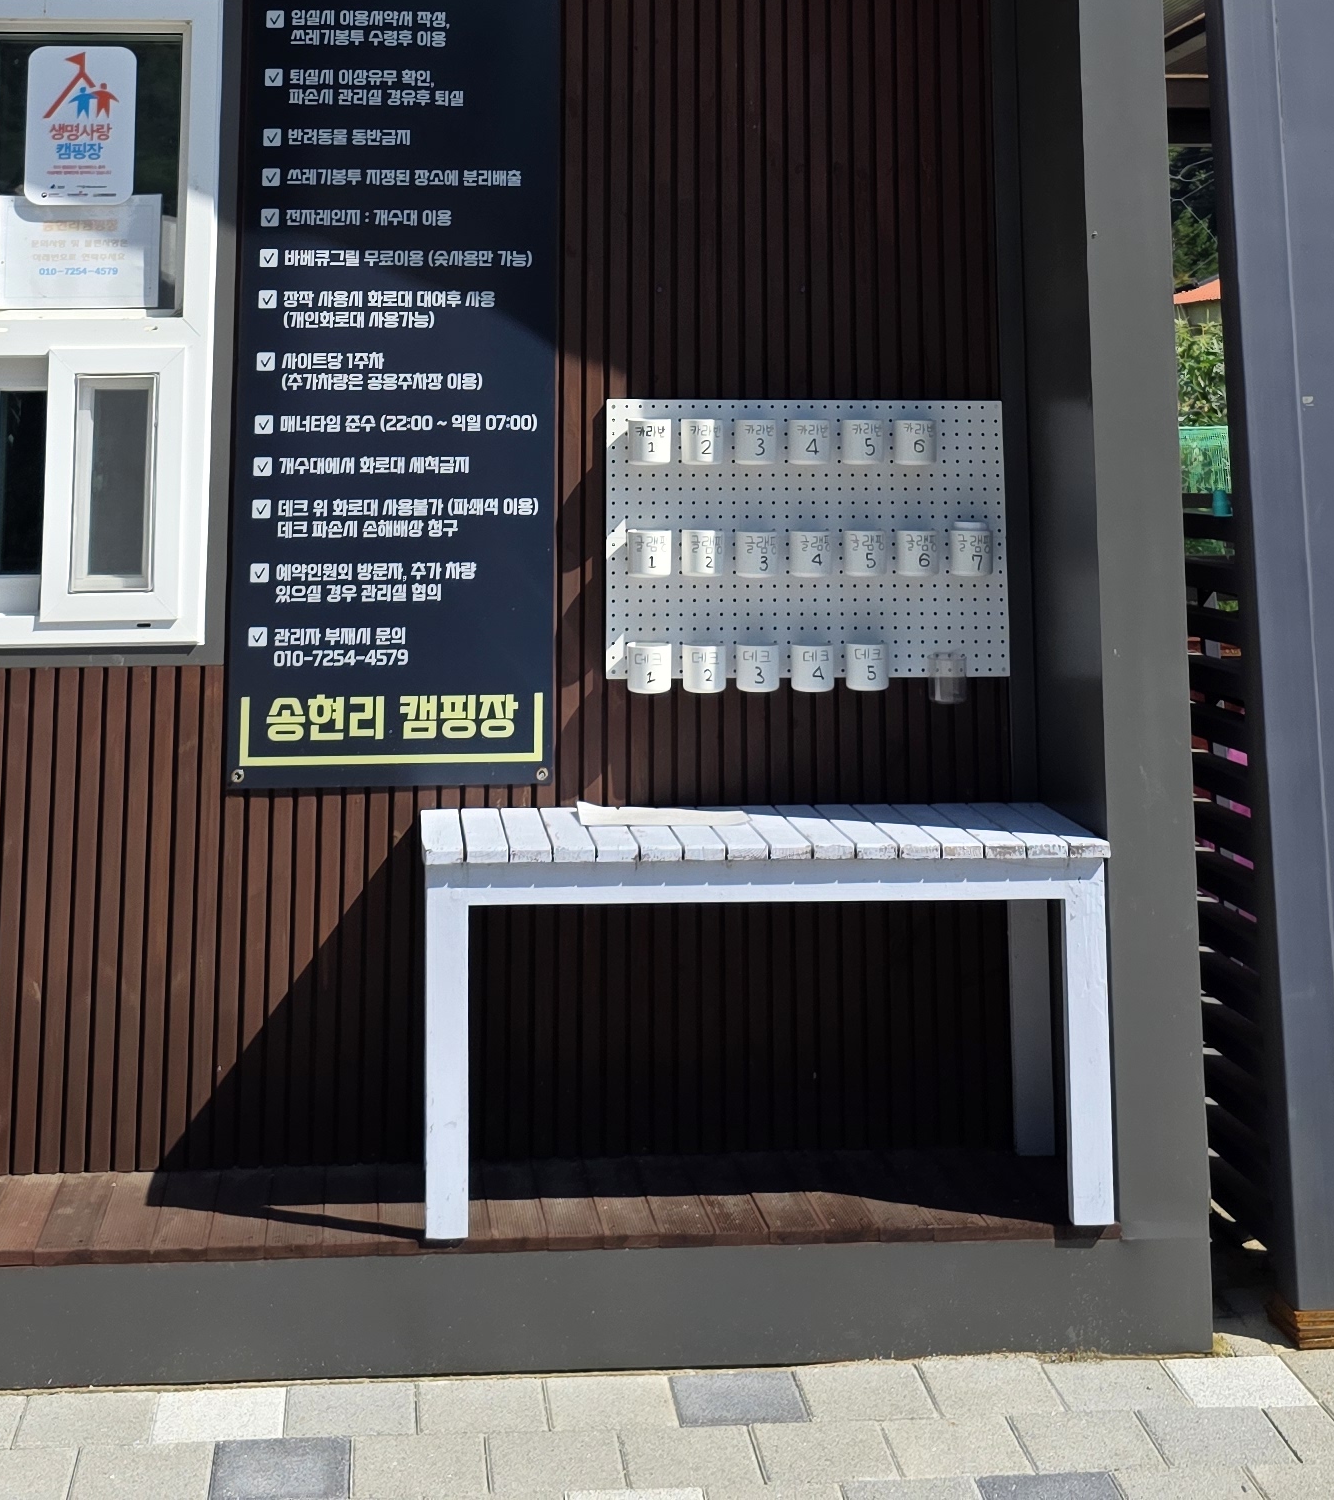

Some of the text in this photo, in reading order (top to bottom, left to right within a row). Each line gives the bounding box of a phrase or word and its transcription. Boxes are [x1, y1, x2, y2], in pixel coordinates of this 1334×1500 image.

[291, 9, 450, 30] 입실시 이용서약서 작성,
[290, 27, 449, 48] 쓰레기봉투 수령후 이용
[289, 68, 435, 88] 퇴실시 이상유무 확인,
[288, 88, 464, 107] 파손시 관리실 경유후 퇴실
[49, 123, 113, 140] 생명사랑
[287, 128, 411, 146] 반려동물 동반금지
[56, 142, 103, 160] 캠핑장
[286, 168, 522, 187] 쓰레기봉투 지정된 장소에 분리배출
[285, 209, 452, 227] 전자레인지 : 개수대 이용
[284, 249, 533, 268] 바베큐그릴 무료이용 (숯사용만 가능)
[39, 267, 119, 276] 010-7254-4579
[283, 289, 496, 308] 장작 사용시 화로대 대여후 사용
[283, 310, 435, 329] (개인화로대 사용가능)
[281, 351, 385, 370] 사이트당 1주차
[281, 372, 483, 391] (추가차량은 공용주차장 이용)
[279, 414, 341, 433] 매너타임
[344, 414, 377, 433] 준수
[379, 414, 434, 433] (22:00
[451, 414, 481, 432] 익일
[485, 413, 538, 432] 07:00)
[635, 425, 665, 438] 카라반
[690, 424, 721, 438] 카라반
[745, 424, 775, 436] 카라반
[797, 424, 829, 438] 카라반
[851, 422, 882, 438] 카라반
[903, 422, 935, 438] 카라반
[648, 442, 655, 452] 1
[701, 440, 712, 454] 2
[755, 438, 765, 456] 3
[805, 438, 819, 455] 4
[865, 438, 875, 456] 5
[913, 439, 925, 453] 6
[278, 455, 470, 475] 개수대에서 화로대 세척금지
[277, 497, 539, 518] 데크 위 화로대 사용불가 (파쇄석 이용)
[277, 518, 459, 539] 데크 파손시 손해배상 청구
[649, 556, 656, 568] 1
[705, 556, 713, 568] 2
[759, 556, 769, 571] 3
[811, 554, 823, 566] 4
[866, 553, 876, 568] 5
[919, 553, 930, 567] 6
[972, 554, 983, 572] 7
[275, 561, 477, 583] 예약인원외 방문자, 추가 차량
[275, 582, 442, 604] 있으실 경우 관리실 협의
[274, 626, 406, 647] 관리자 부재시 문의
[273, 648, 409, 667] 010-7254-4579
[635, 653, 661, 666] 데크
[691, 652, 719, 664] 데크
[743, 650, 771, 662] 데크
[803, 650, 829, 662] 데크
[854, 648, 883, 660] 데크
[646, 672, 655, 684] 1
[703, 669, 713, 682] 2
[755, 666, 765, 684] 3
[813, 666, 824, 680] 4
[867, 666, 876, 680] 5
[265, 693, 519, 742] 송현리 캠핑장
